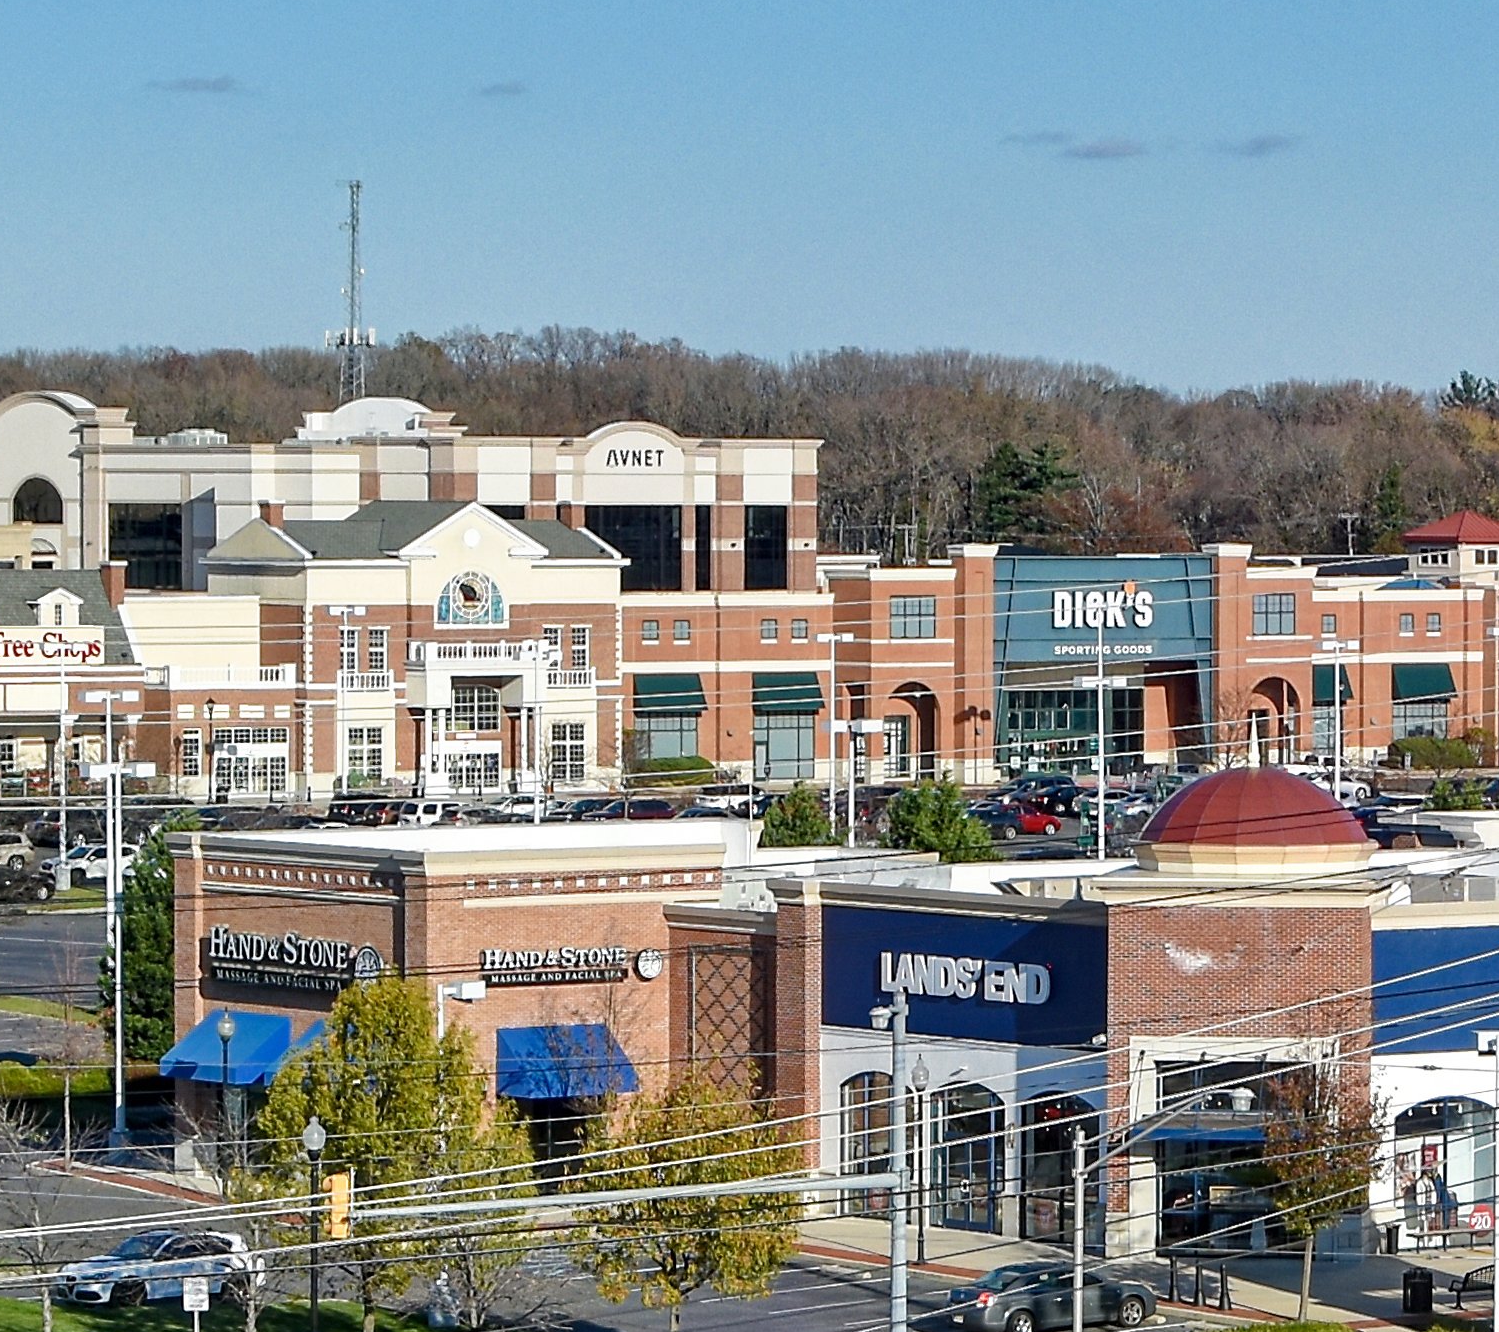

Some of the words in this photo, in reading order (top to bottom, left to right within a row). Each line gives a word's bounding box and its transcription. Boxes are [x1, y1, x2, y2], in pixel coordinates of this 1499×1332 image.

[605, 449, 665, 467] AVNET
[1052, 588, 1154, 628] DICK'S
[1114, 645, 1153, 654] GOODS
[208, 924, 267, 961] HAND
[268, 936, 280, 960] &
[283, 931, 348, 968] STONE
[483, 949, 542, 969] HAND
[560, 947, 627, 967] STONE
[216, 969, 259, 984] MASSAGE
[324, 980, 342, 992] SPA
[491, 973, 536, 983] MASSAGE
[541, 972, 562, 981] AND
[565, 971, 600, 981] FACIAL
[604, 970, 622, 980] SPA
[881, 951, 983, 999] LANDS'
[984, 960, 1051, 1005] END
